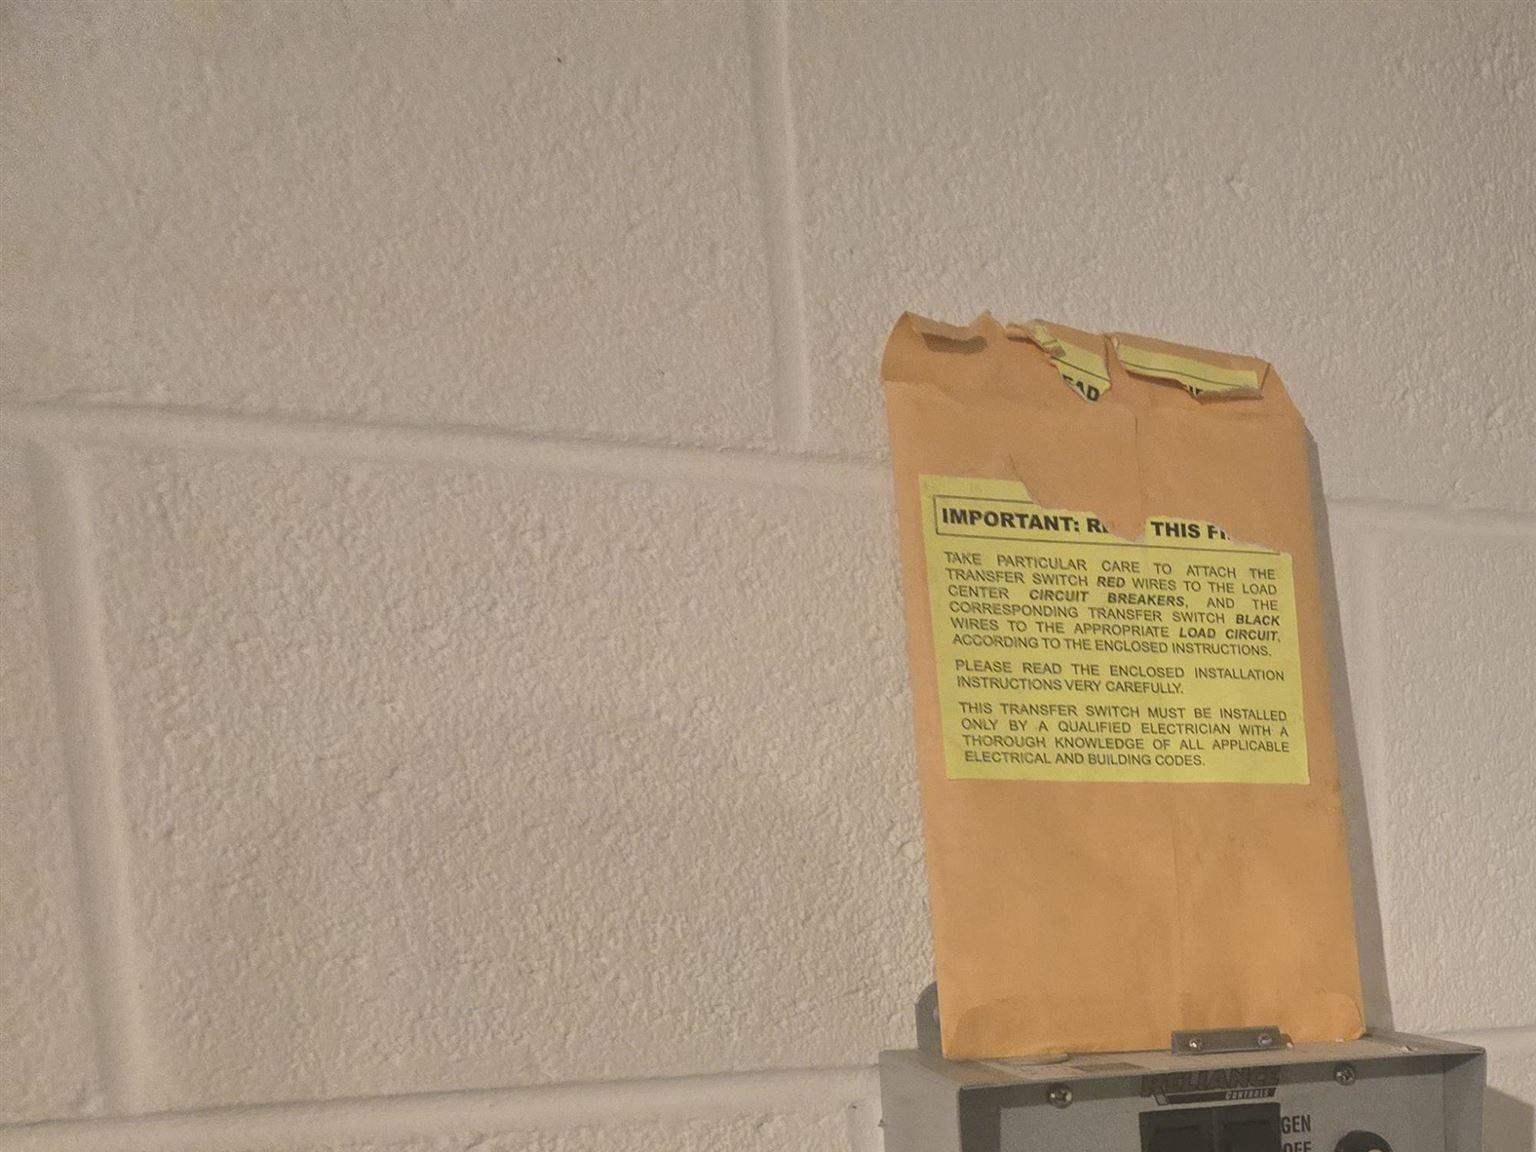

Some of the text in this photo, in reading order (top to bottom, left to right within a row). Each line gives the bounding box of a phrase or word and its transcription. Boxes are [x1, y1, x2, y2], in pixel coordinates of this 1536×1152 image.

[942, 508, 1080, 531] IMPORTANT:
[1151, 522, 1200, 538] THIS
[944, 551, 1275, 580] TAKE PARTICULAR CARE TO ATTACH THE
[946, 568, 1277, 595] TRANSFER SWITCH RED WIRES TO THE LOAD
[948, 585, 1009, 599] CENTER
[1029, 589, 1089, 602] CIRCUIT
[1207, 598, 1234, 609] AND
[1252, 600, 1278, 611] THE
[949, 601, 1280, 625] CORRESPONDING TRANSFER SWITCH BLACK
[950, 617, 999, 631] WIRES
[1007, 620, 1027, 632] TO
[1036, 621, 1064, 633] THE
[1074, 623, 1169, 637] APPROPRIATE
[1179, 628, 1215, 638] LOAD
[953, 634, 1271, 656] ACCORDING TO THE ENCLOSED INSTRUCTIONS.
[955, 659, 1284, 681] PLEASE READ THE ENCLOSED INSTALLATION
[957, 676, 1183, 694] INSTRUCTIONS VERY CAREFULLY.
[958, 702, 1287, 721] THIS TRANSFER SWITCH MUST BE INSTALLED
[961, 718, 1288, 737] ONLY BY A QUALIFIED ELECTRICIAN WITH A
[962, 735, 1290, 753] THOROUGH KNOWLEDGE OF ALL APPLICABLE
[965, 751, 1205, 766] ELECTRICAL AND BUILDING CODES.
[1281, 1115, 1311, 1134] GEN
